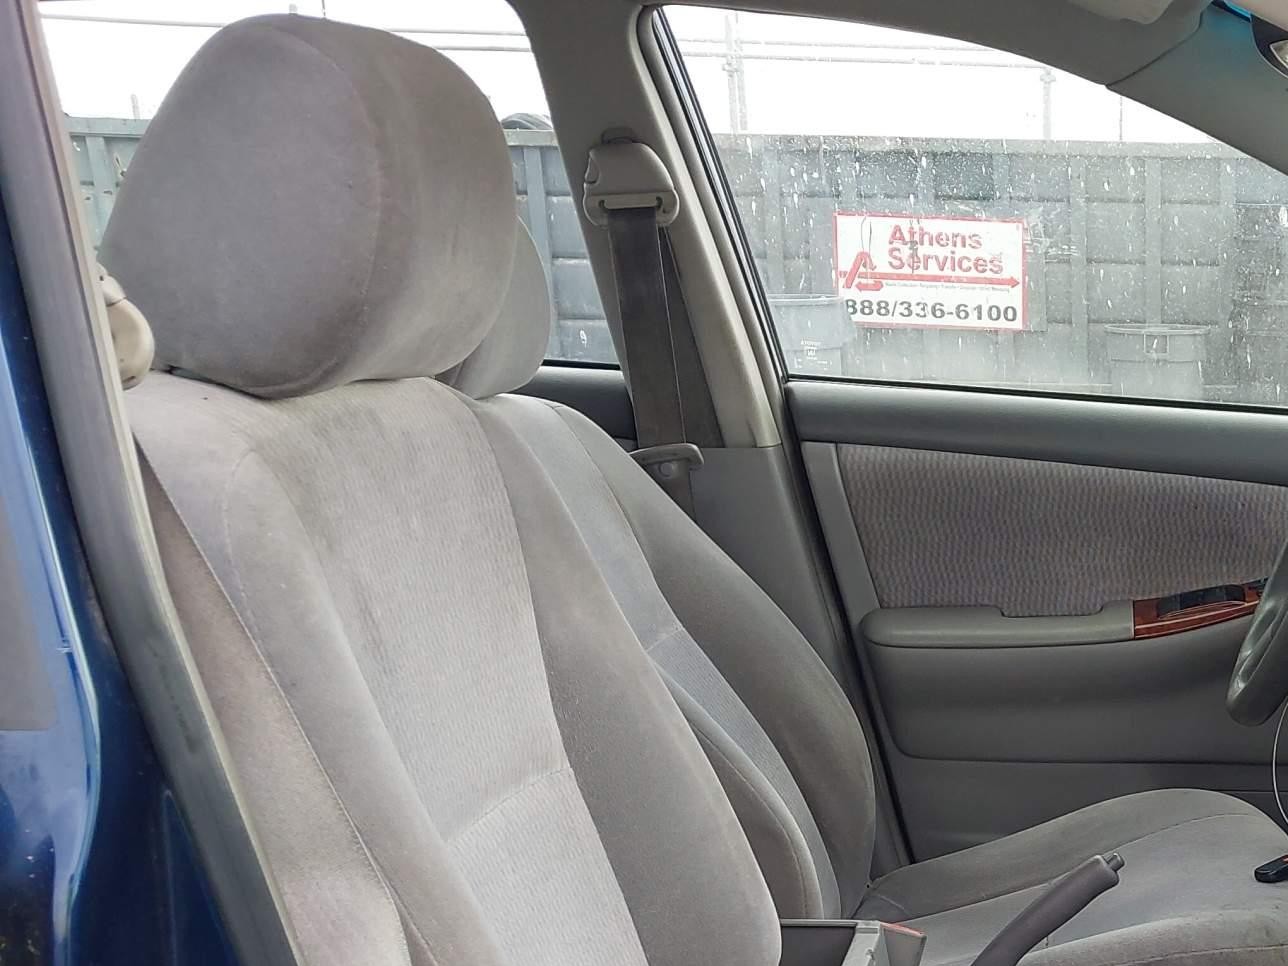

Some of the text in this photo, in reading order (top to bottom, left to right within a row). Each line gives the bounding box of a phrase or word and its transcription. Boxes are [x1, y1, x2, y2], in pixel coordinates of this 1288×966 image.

[888, 224, 982, 248] Athens
[888, 247, 1004, 274] Services
[845, 298, 1017, 322] 888/336-6100
